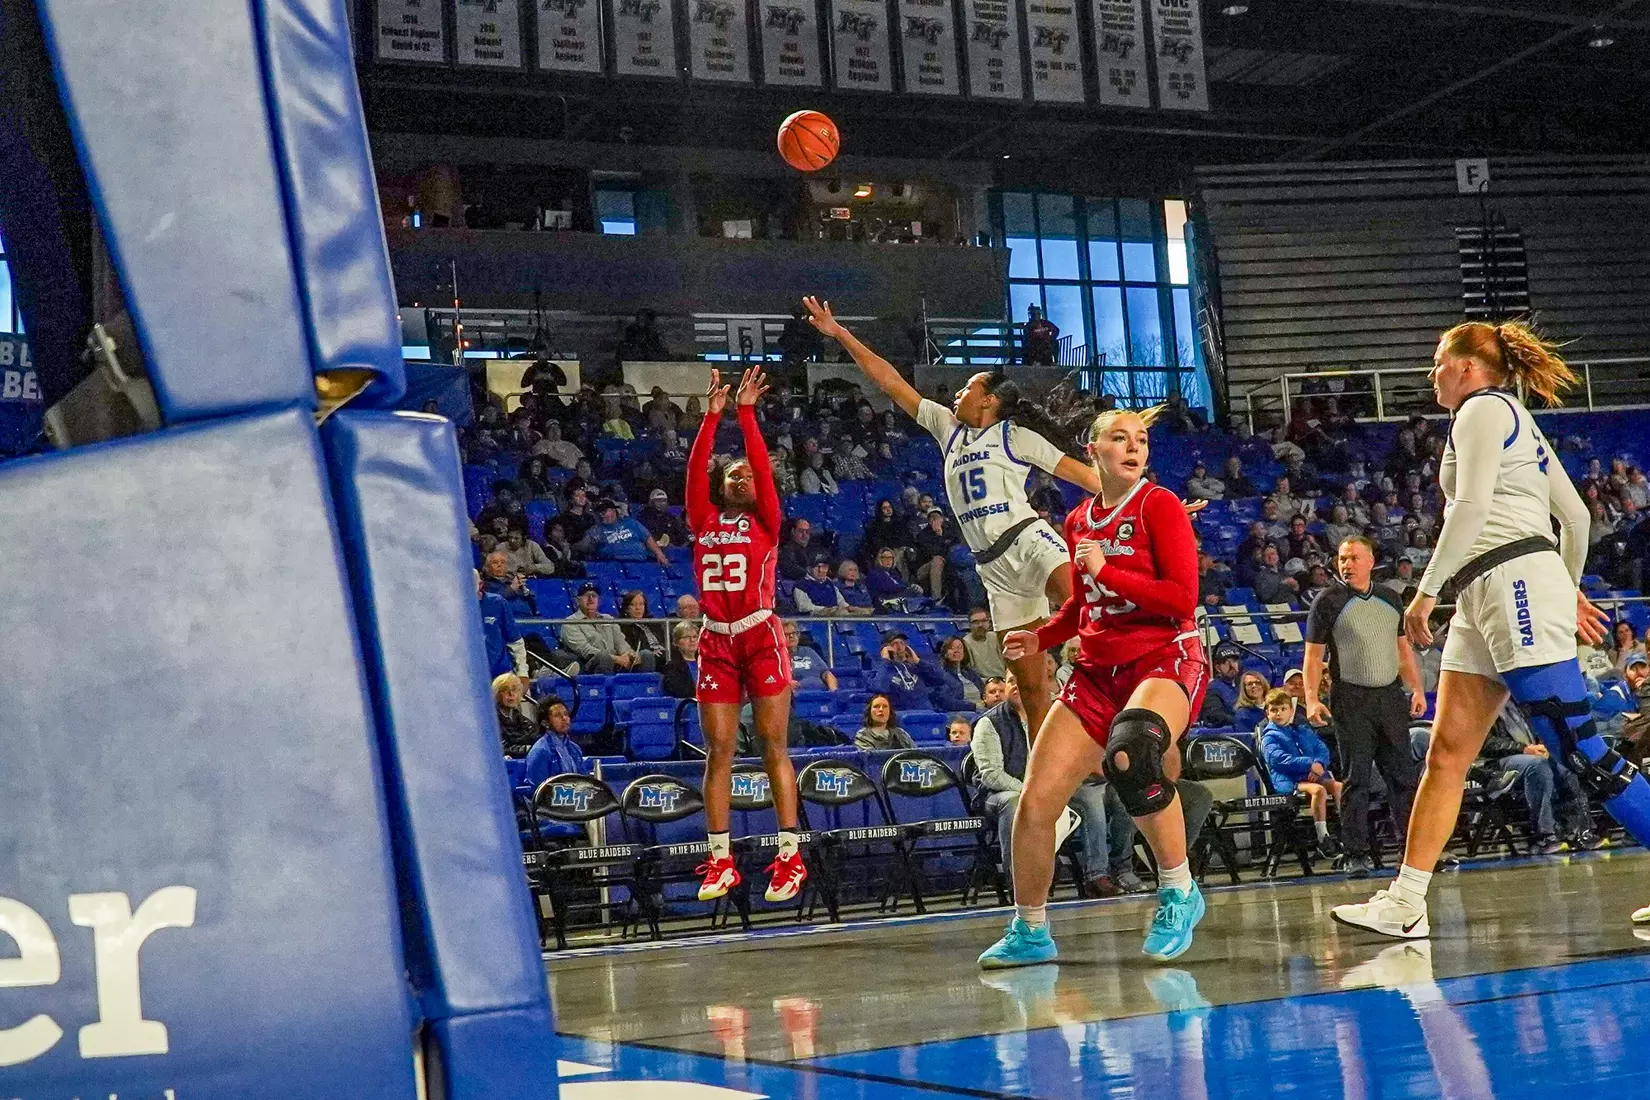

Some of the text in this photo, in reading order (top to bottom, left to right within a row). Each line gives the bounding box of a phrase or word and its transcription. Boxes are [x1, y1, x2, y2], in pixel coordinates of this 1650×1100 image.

[1466, 165, 1479, 186] F
[2, 370, 44, 400] BE
[959, 467, 987, 505] 15
[701, 553, 747, 592] 23
[1513, 579, 1535, 648] RAIDERS
[1203, 743, 1237, 768] MT
[814, 771, 853, 798] MT
[900, 763, 937, 788] MT
[552, 785, 594, 811] MT
[639, 786, 682, 812] MT
[731, 776, 770, 802] MT
[1245, 799, 1260, 808] BLUE
[849, 828, 898, 840] BLUE RAIDERS
[935, 819, 982, 832] BLUE RAIDERS
[578, 846, 632, 860] BLUE RAIDERS
[669, 843, 712, 856] BLUE RAIDE
[761, 836, 779, 847] BLUE
